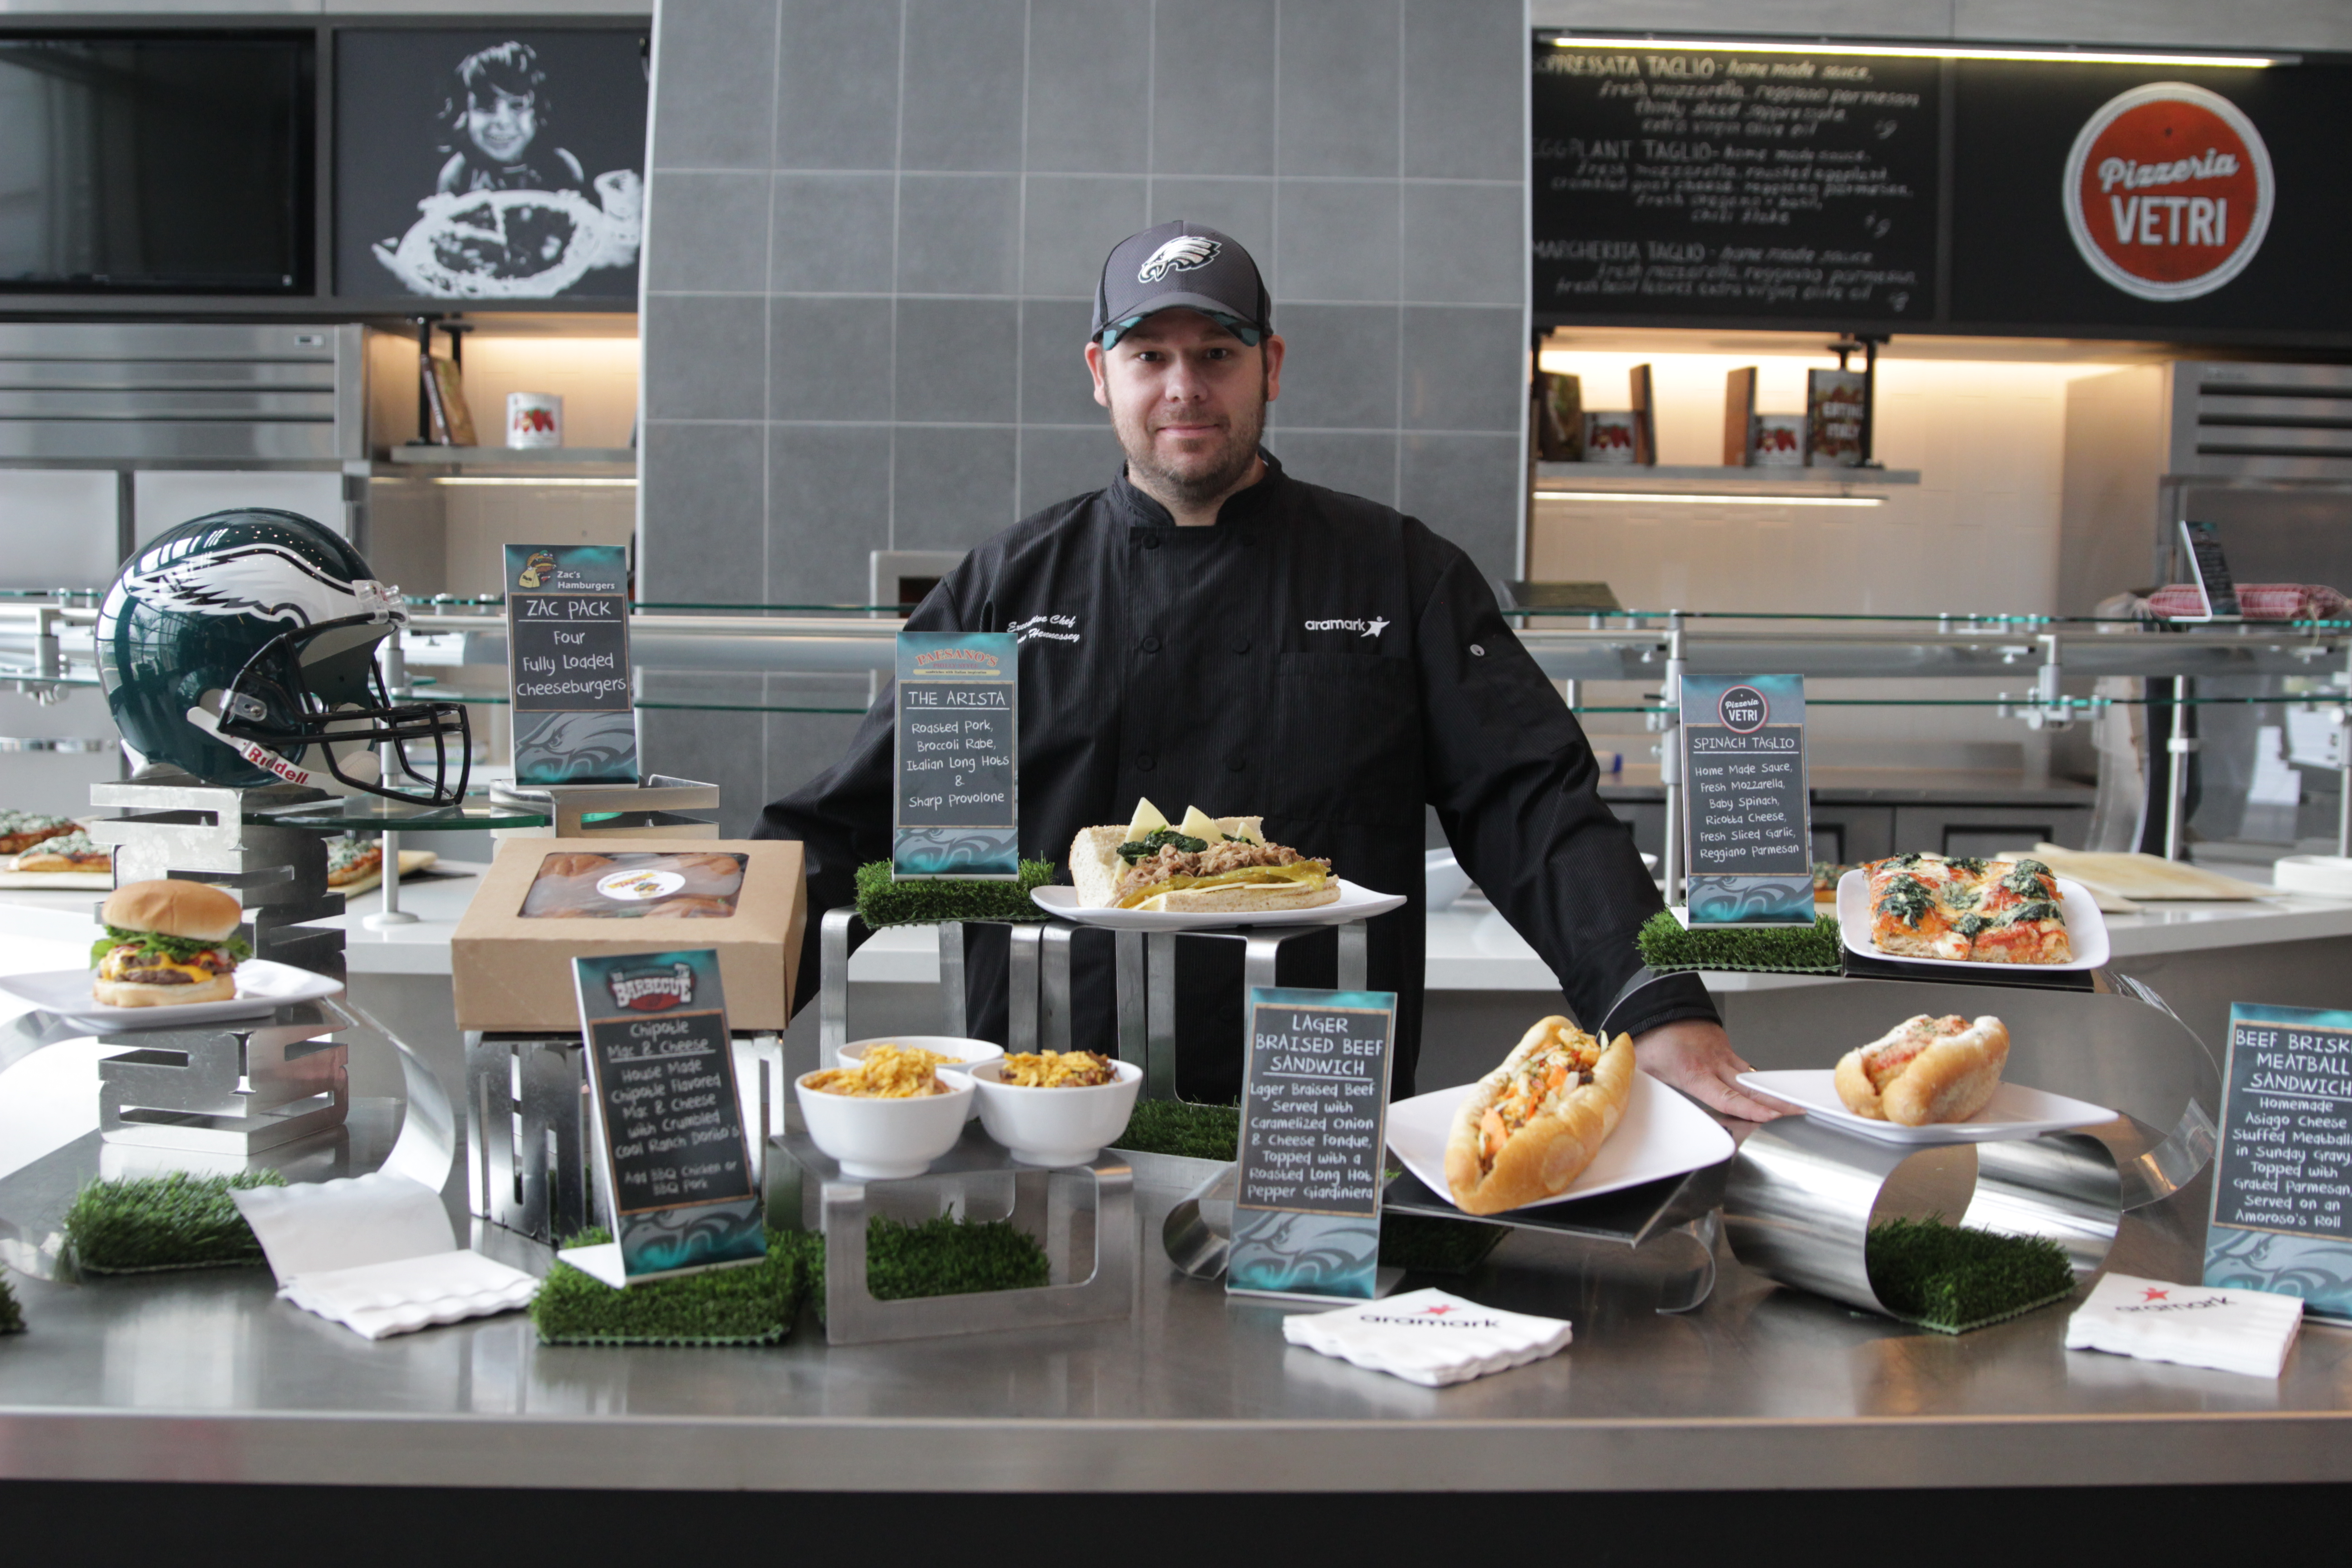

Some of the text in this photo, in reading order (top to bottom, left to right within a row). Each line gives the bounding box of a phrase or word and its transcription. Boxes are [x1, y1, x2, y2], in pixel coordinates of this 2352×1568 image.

[1645, 55, 1715, 79] TAGLIO
[2098, 147, 2240, 193] Pizzeria
[2110, 195, 2227, 246] VETRI
[558, 582, 615, 590] Hamburgers
[526, 599, 611, 619] ZAC PACK
[1050, 615, 1076, 628] Chef
[1305, 618, 1365, 631] aramark
[554, 631, 585, 645] Four
[1029, 628, 1080, 643] Hennessey
[523, 652, 613, 676] Fully Loaded
[915, 648, 998, 667] PAESANO'S
[517, 678, 626, 699] Cheeseburgers
[908, 691, 1006, 706] THE ARISTA
[1725, 699, 1759, 709] Pizzeria
[1728, 710, 1757, 721] VETRI
[912, 720, 994, 734] Roasted Pork,
[917, 738, 996, 752] Broccoli Rabe,
[1694, 737, 1794, 749] SPINACH TAGLIO
[907, 756, 1009, 773] Italian Long Hots
[1695, 763, 1793, 776] Home Made Sauce,
[955, 775, 965, 786] &
[1701, 783, 1726, 793] Fresh
[909, 792, 1004, 811] Sharp Provolone
[1709, 797, 1780, 811] Baby Spinach,
[1706, 813, 1787, 825] Ricotta Cheese,
[1700, 827, 1796, 842] Fresh Sliced Garlic,
[1700, 844, 1799, 862] Reggiano Parmesan
[612, 977, 691, 1007] BARBECUE
[630, 1019, 689, 1042] Chipotle
[1293, 1014, 1348, 1033] LAGER
[607, 1039, 709, 1058] Mac & Cheese
[1255, 1034, 1384, 1056] BRAISED BEEF
[2236, 1029, 2352, 1054] BEEF BRISK
[621, 1058, 702, 1083] House Made
[1271, 1057, 1364, 1076] SANDWICH
[2257, 1052, 2350, 1076] MEATBALL
[1250, 1082, 1376, 1101] Lager Braised Beef
[2250, 1071, 2352, 1096] SANDWICH
[611, 1083, 666, 1105] Chipotle
[622, 1093, 716, 1120] Mac & Cheese
[1271, 1100, 1353, 1115] Served with
[2260, 1097, 2333, 1113] Homemade
[627, 1109, 720, 1139] with Crumbled
[1251, 1117, 1373, 1132] Caramelized Onion
[2246, 1112, 2347, 1131] Asiago Cheese
[1251, 1133, 1372, 1149] & Cheese Fondue,
[2232, 1128, 2352, 1145] Stuffed Meatball
[615, 1141, 644, 1159] Cool
[648, 1135, 687, 1152] Ranch
[2236, 1144, 2248, 1156] in
[2255, 1146, 2306, 1164] Sunday
[1262, 1150, 1361, 1168] Topped with a
[624, 1161, 737, 1184] Add BBQ Chicken or
[1250, 1167, 1372, 1187] Roasted Long Hot
[2250, 1161, 2337, 1179] Topped with
[653, 1179, 708, 1196] BBQ Pork
[1248, 1184, 1373, 1202] Pepper Giardiniera
[2233, 1178, 2278, 1193] Grated
[2244, 1195, 2340, 1211] Served on an
[2235, 1208, 2340, 1228] Amoroso's Roll
[1360, 1314, 1500, 1328] aramark
